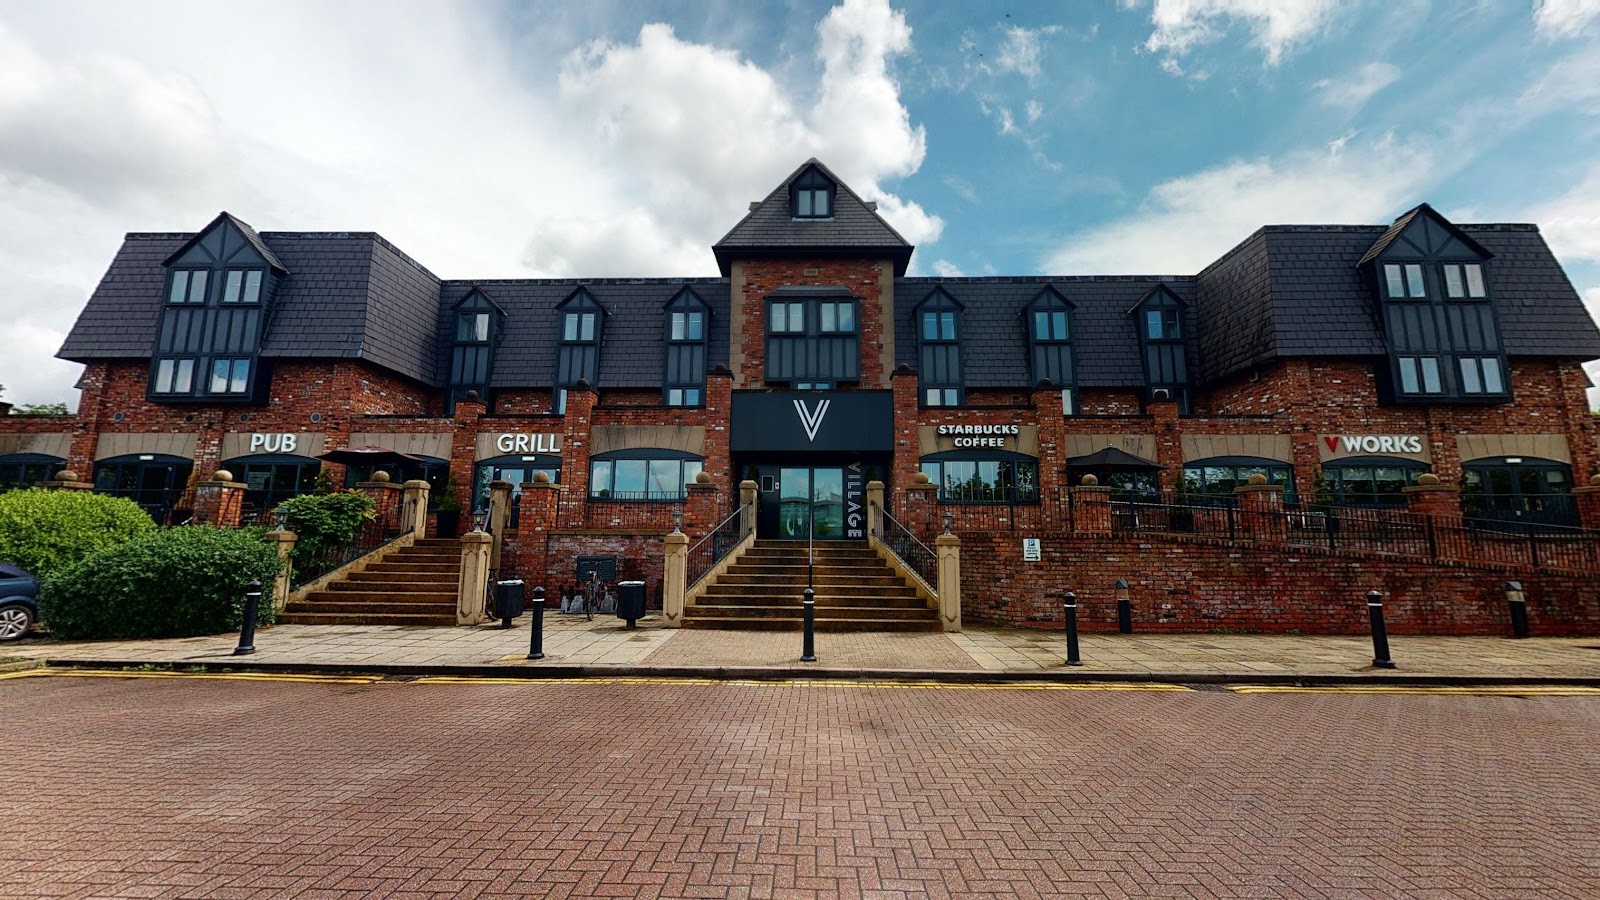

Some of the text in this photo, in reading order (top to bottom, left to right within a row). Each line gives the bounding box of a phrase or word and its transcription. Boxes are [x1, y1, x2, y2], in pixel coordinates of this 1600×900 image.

[793, 399, 831, 442] V
[938, 424, 1019, 434] STARBUCKS
[250, 433, 297, 452] PUB
[497, 433, 561, 453] GRILL
[954, 437, 1005, 447] COFFEE
[847, 461, 862, 538] VILLAGE
